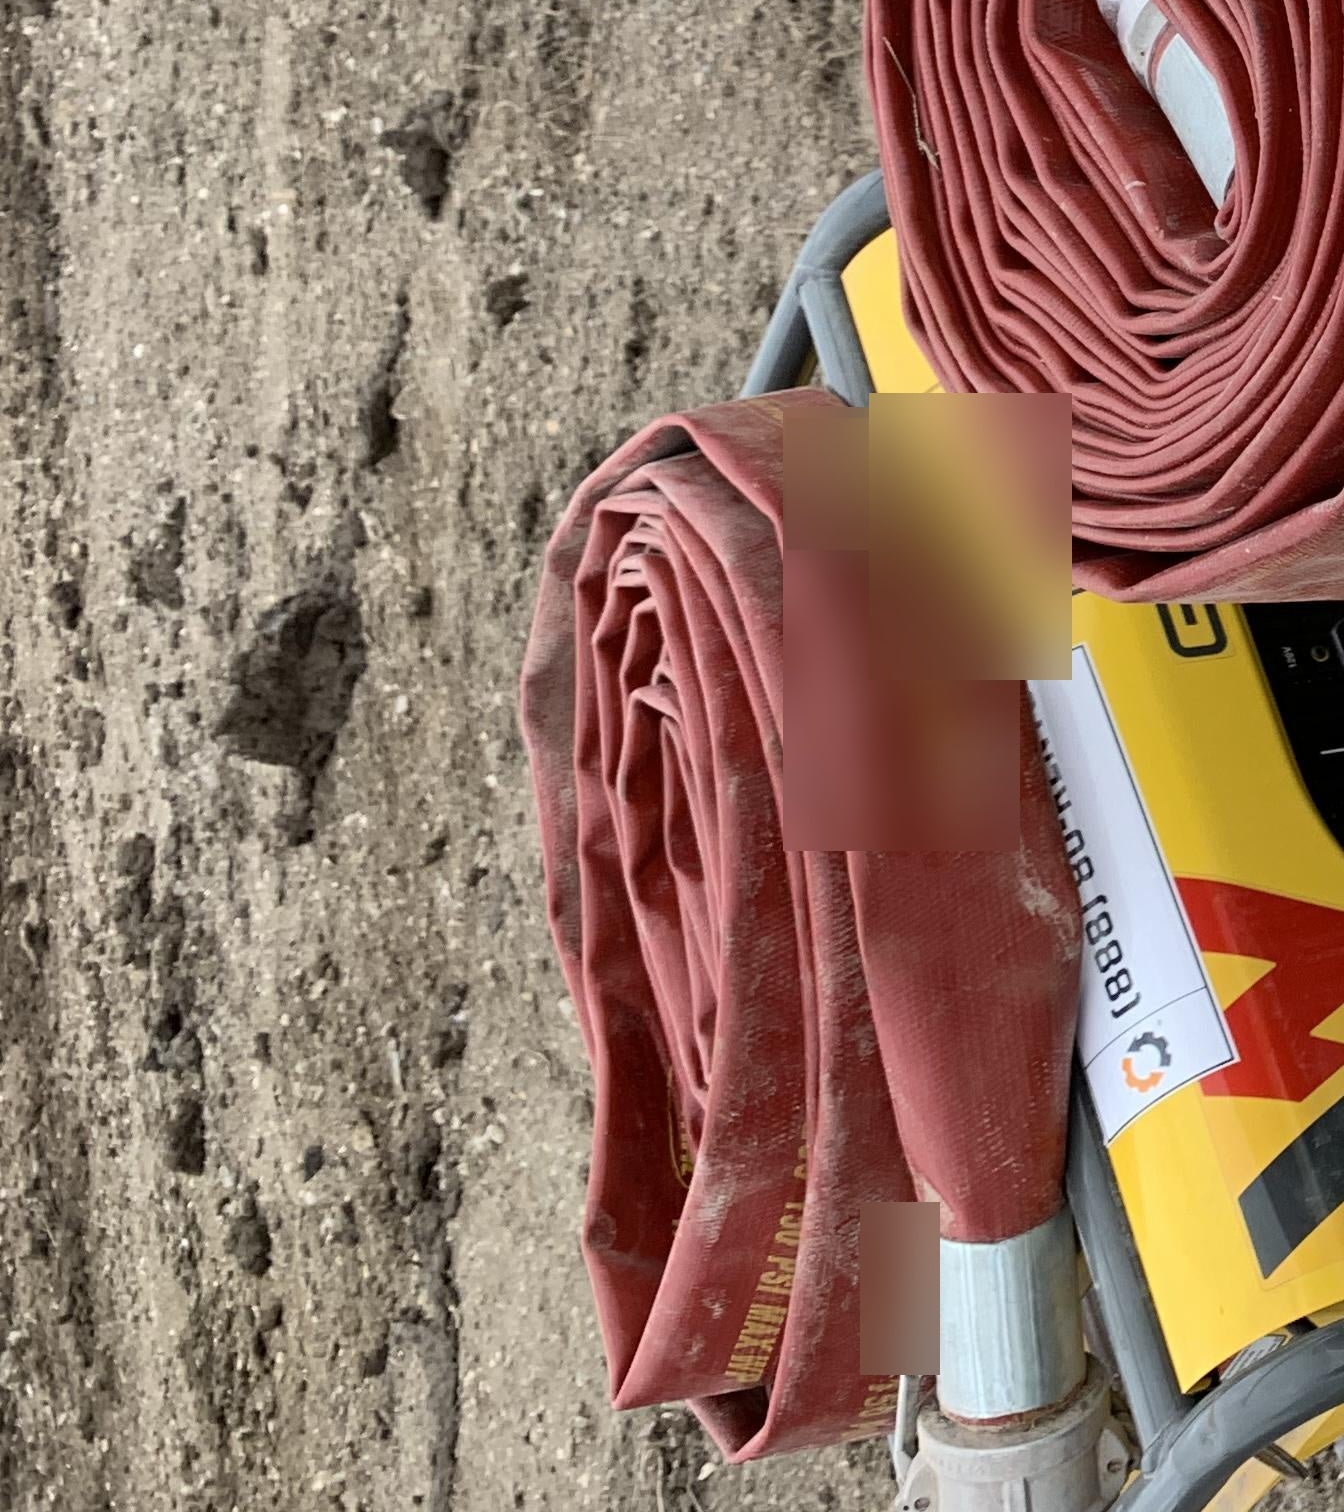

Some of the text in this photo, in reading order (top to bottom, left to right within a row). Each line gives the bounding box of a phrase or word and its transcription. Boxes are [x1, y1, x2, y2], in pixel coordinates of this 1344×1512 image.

[1081, 894, 1141, 1019] (888)
[756, 1255, 798, 1294] PSI
[734, 1303, 789, 1350] MAX
